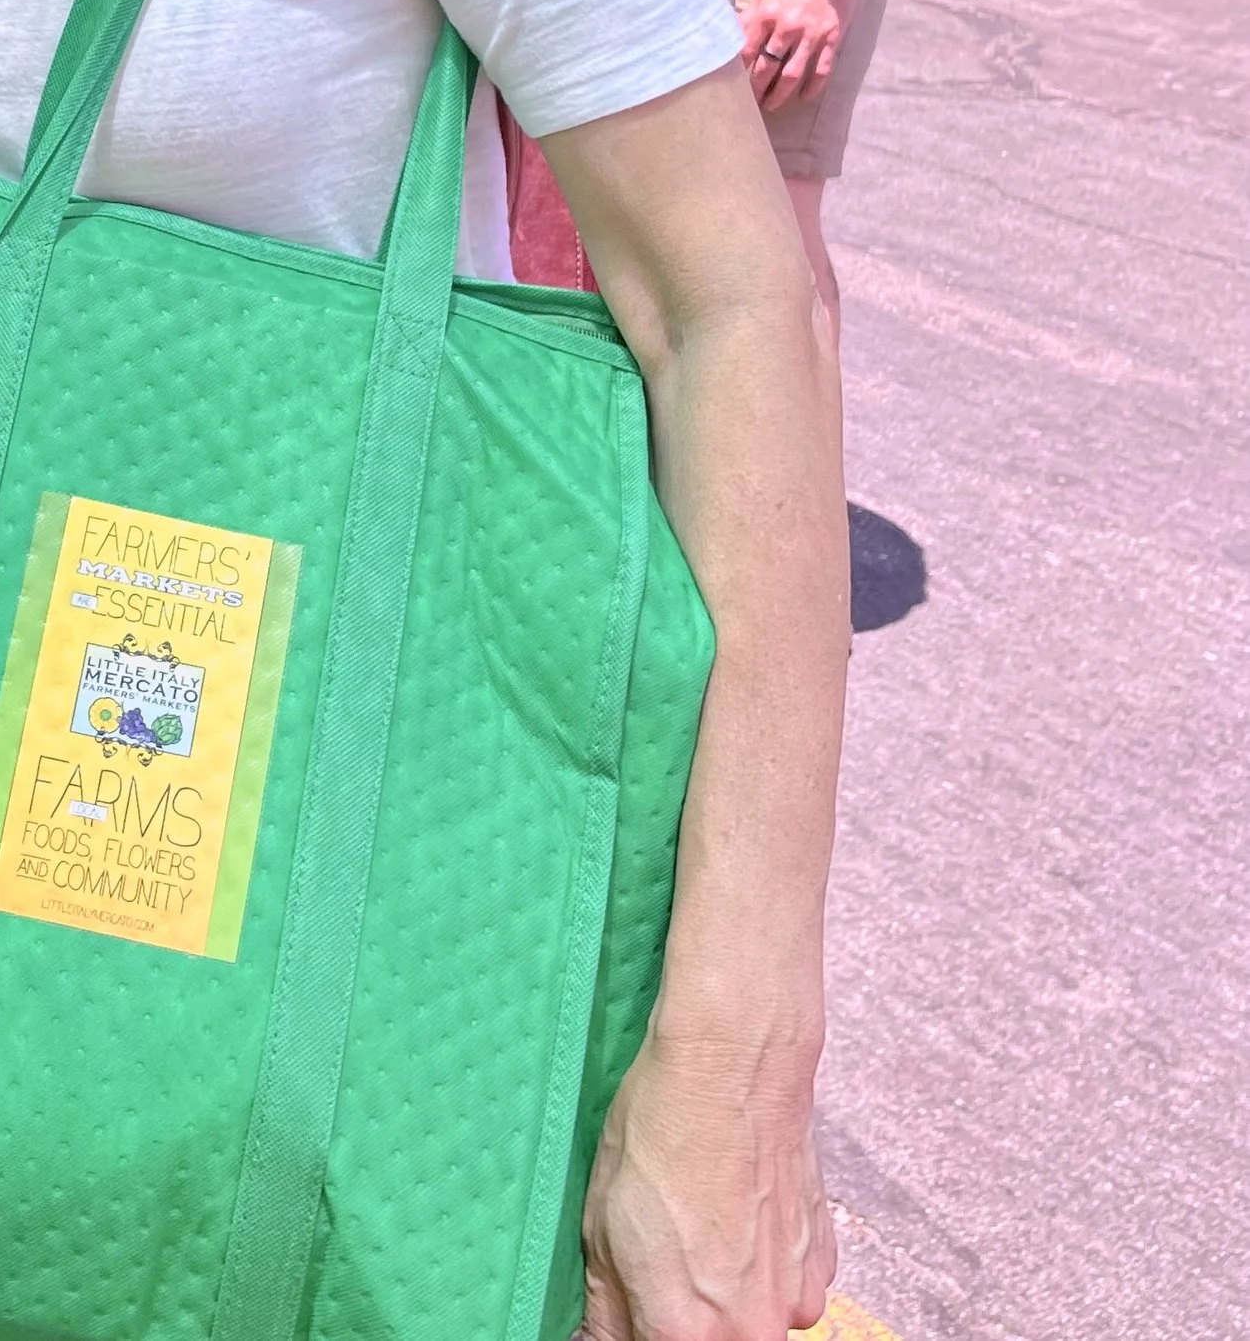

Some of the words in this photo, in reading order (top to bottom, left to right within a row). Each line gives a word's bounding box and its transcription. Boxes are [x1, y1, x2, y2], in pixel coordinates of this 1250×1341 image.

[81, 515, 252, 586] FARMERS'
[77, 557, 245, 608] MARKETS
[92, 585, 236, 645] ESSENTIAL
[82, 682, 139, 700] FARMERS'
[142, 695, 197, 713] MARKETS
[84, 668, 199, 703] MERCATO
[87, 656, 146, 677] LITTLE
[152, 670, 201, 689] ITALY
[29, 755, 203, 848] FARMS
[22, 820, 94, 863] FOODS,
[103, 837, 196, 881] FLOWERS
[17, 858, 49, 879] AND
[52, 860, 193, 915] COMMUNITY
